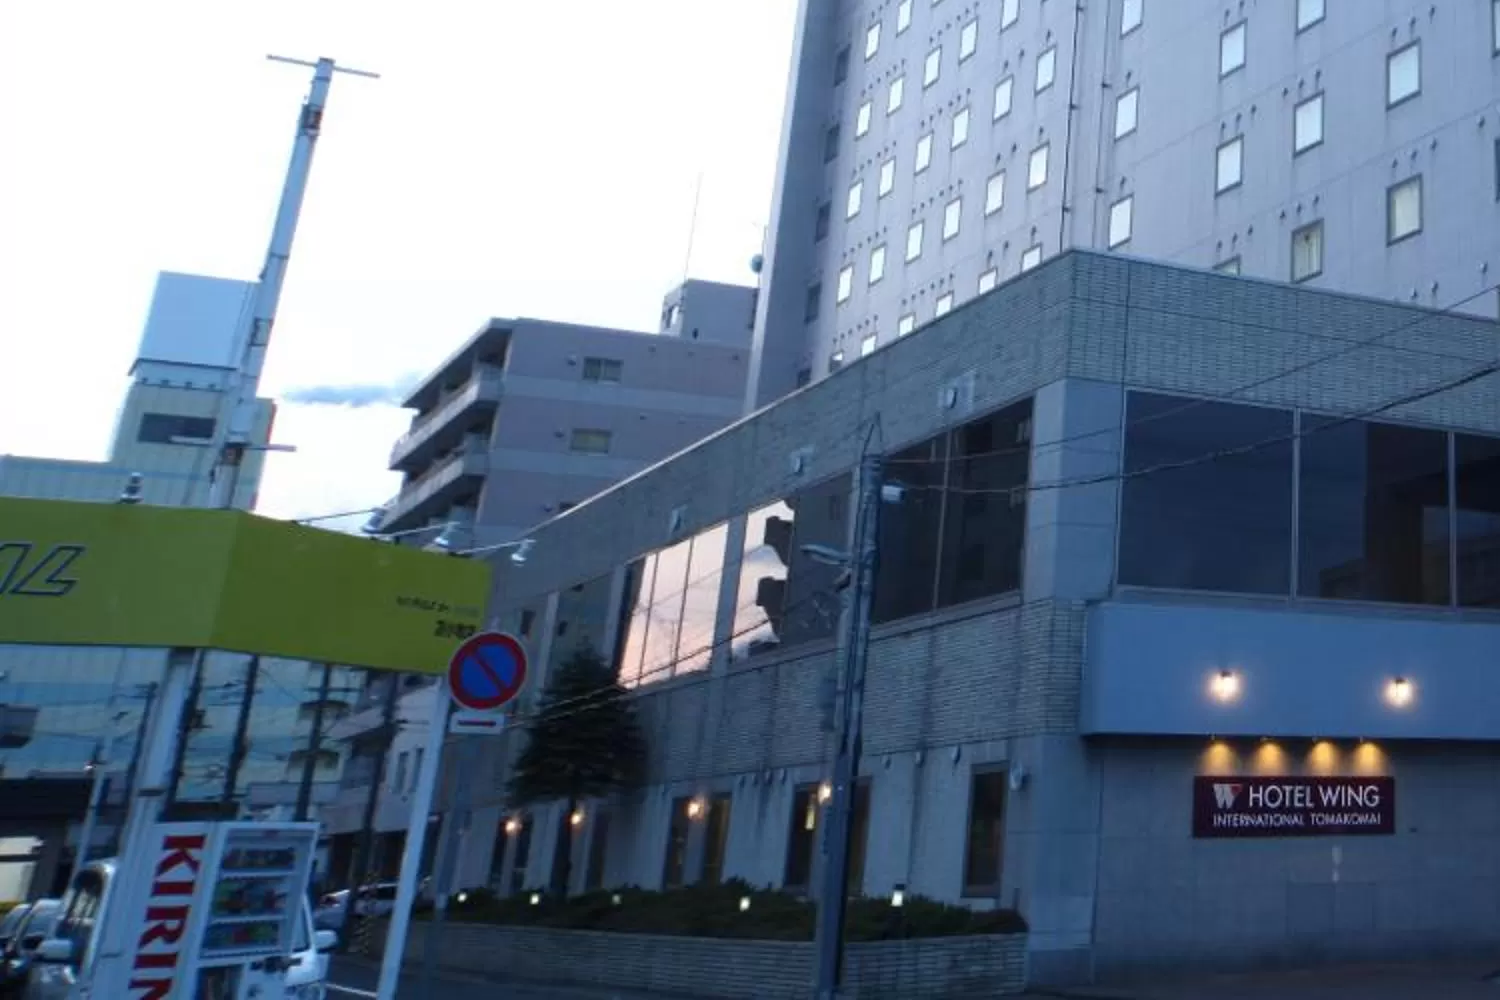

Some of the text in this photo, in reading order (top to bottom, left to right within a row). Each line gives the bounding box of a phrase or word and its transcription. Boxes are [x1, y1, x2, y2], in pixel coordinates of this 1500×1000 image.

[1249, 785, 1315, 809] HOTEL
[1317, 784, 1381, 808] WING
[1213, 811, 1382, 828] INTERNATIONAL TOMAKOMAI
